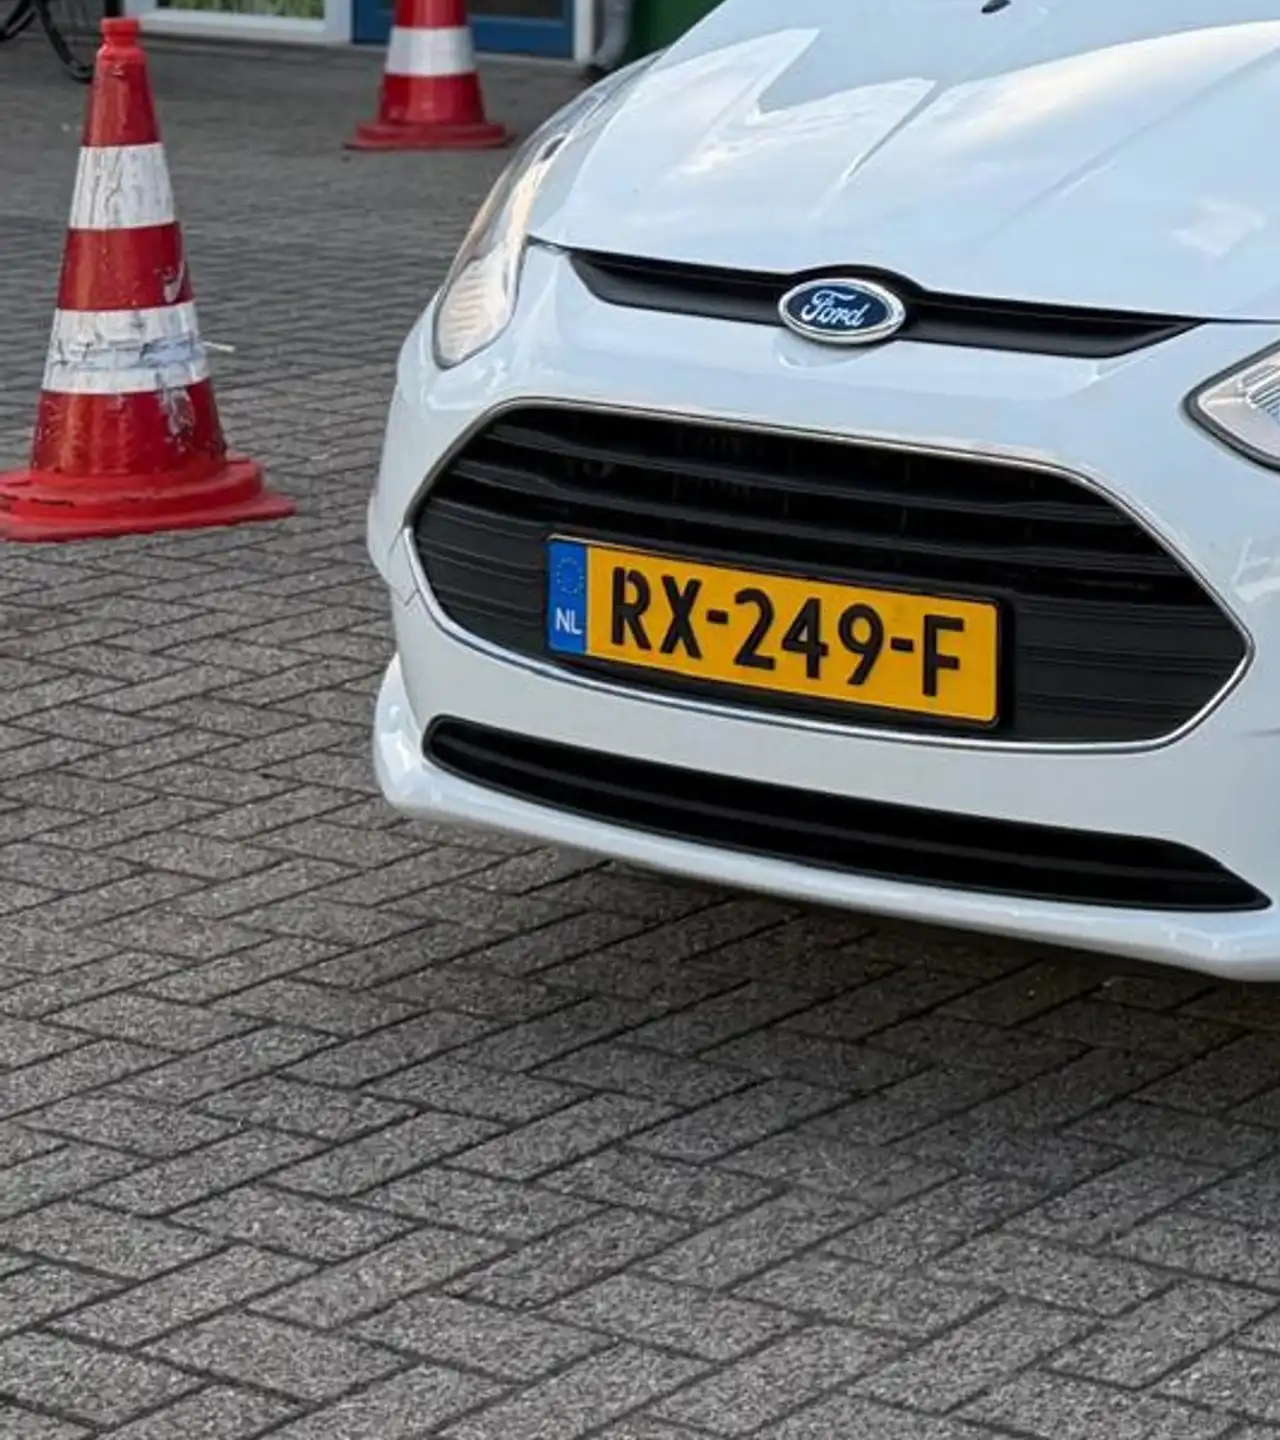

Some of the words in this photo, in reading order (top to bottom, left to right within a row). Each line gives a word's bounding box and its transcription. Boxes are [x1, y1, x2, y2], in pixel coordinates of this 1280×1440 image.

[801, 289, 872, 327] Ford
[556, 607, 583, 636] NL
[611, 566, 965, 697] RX-249-F
